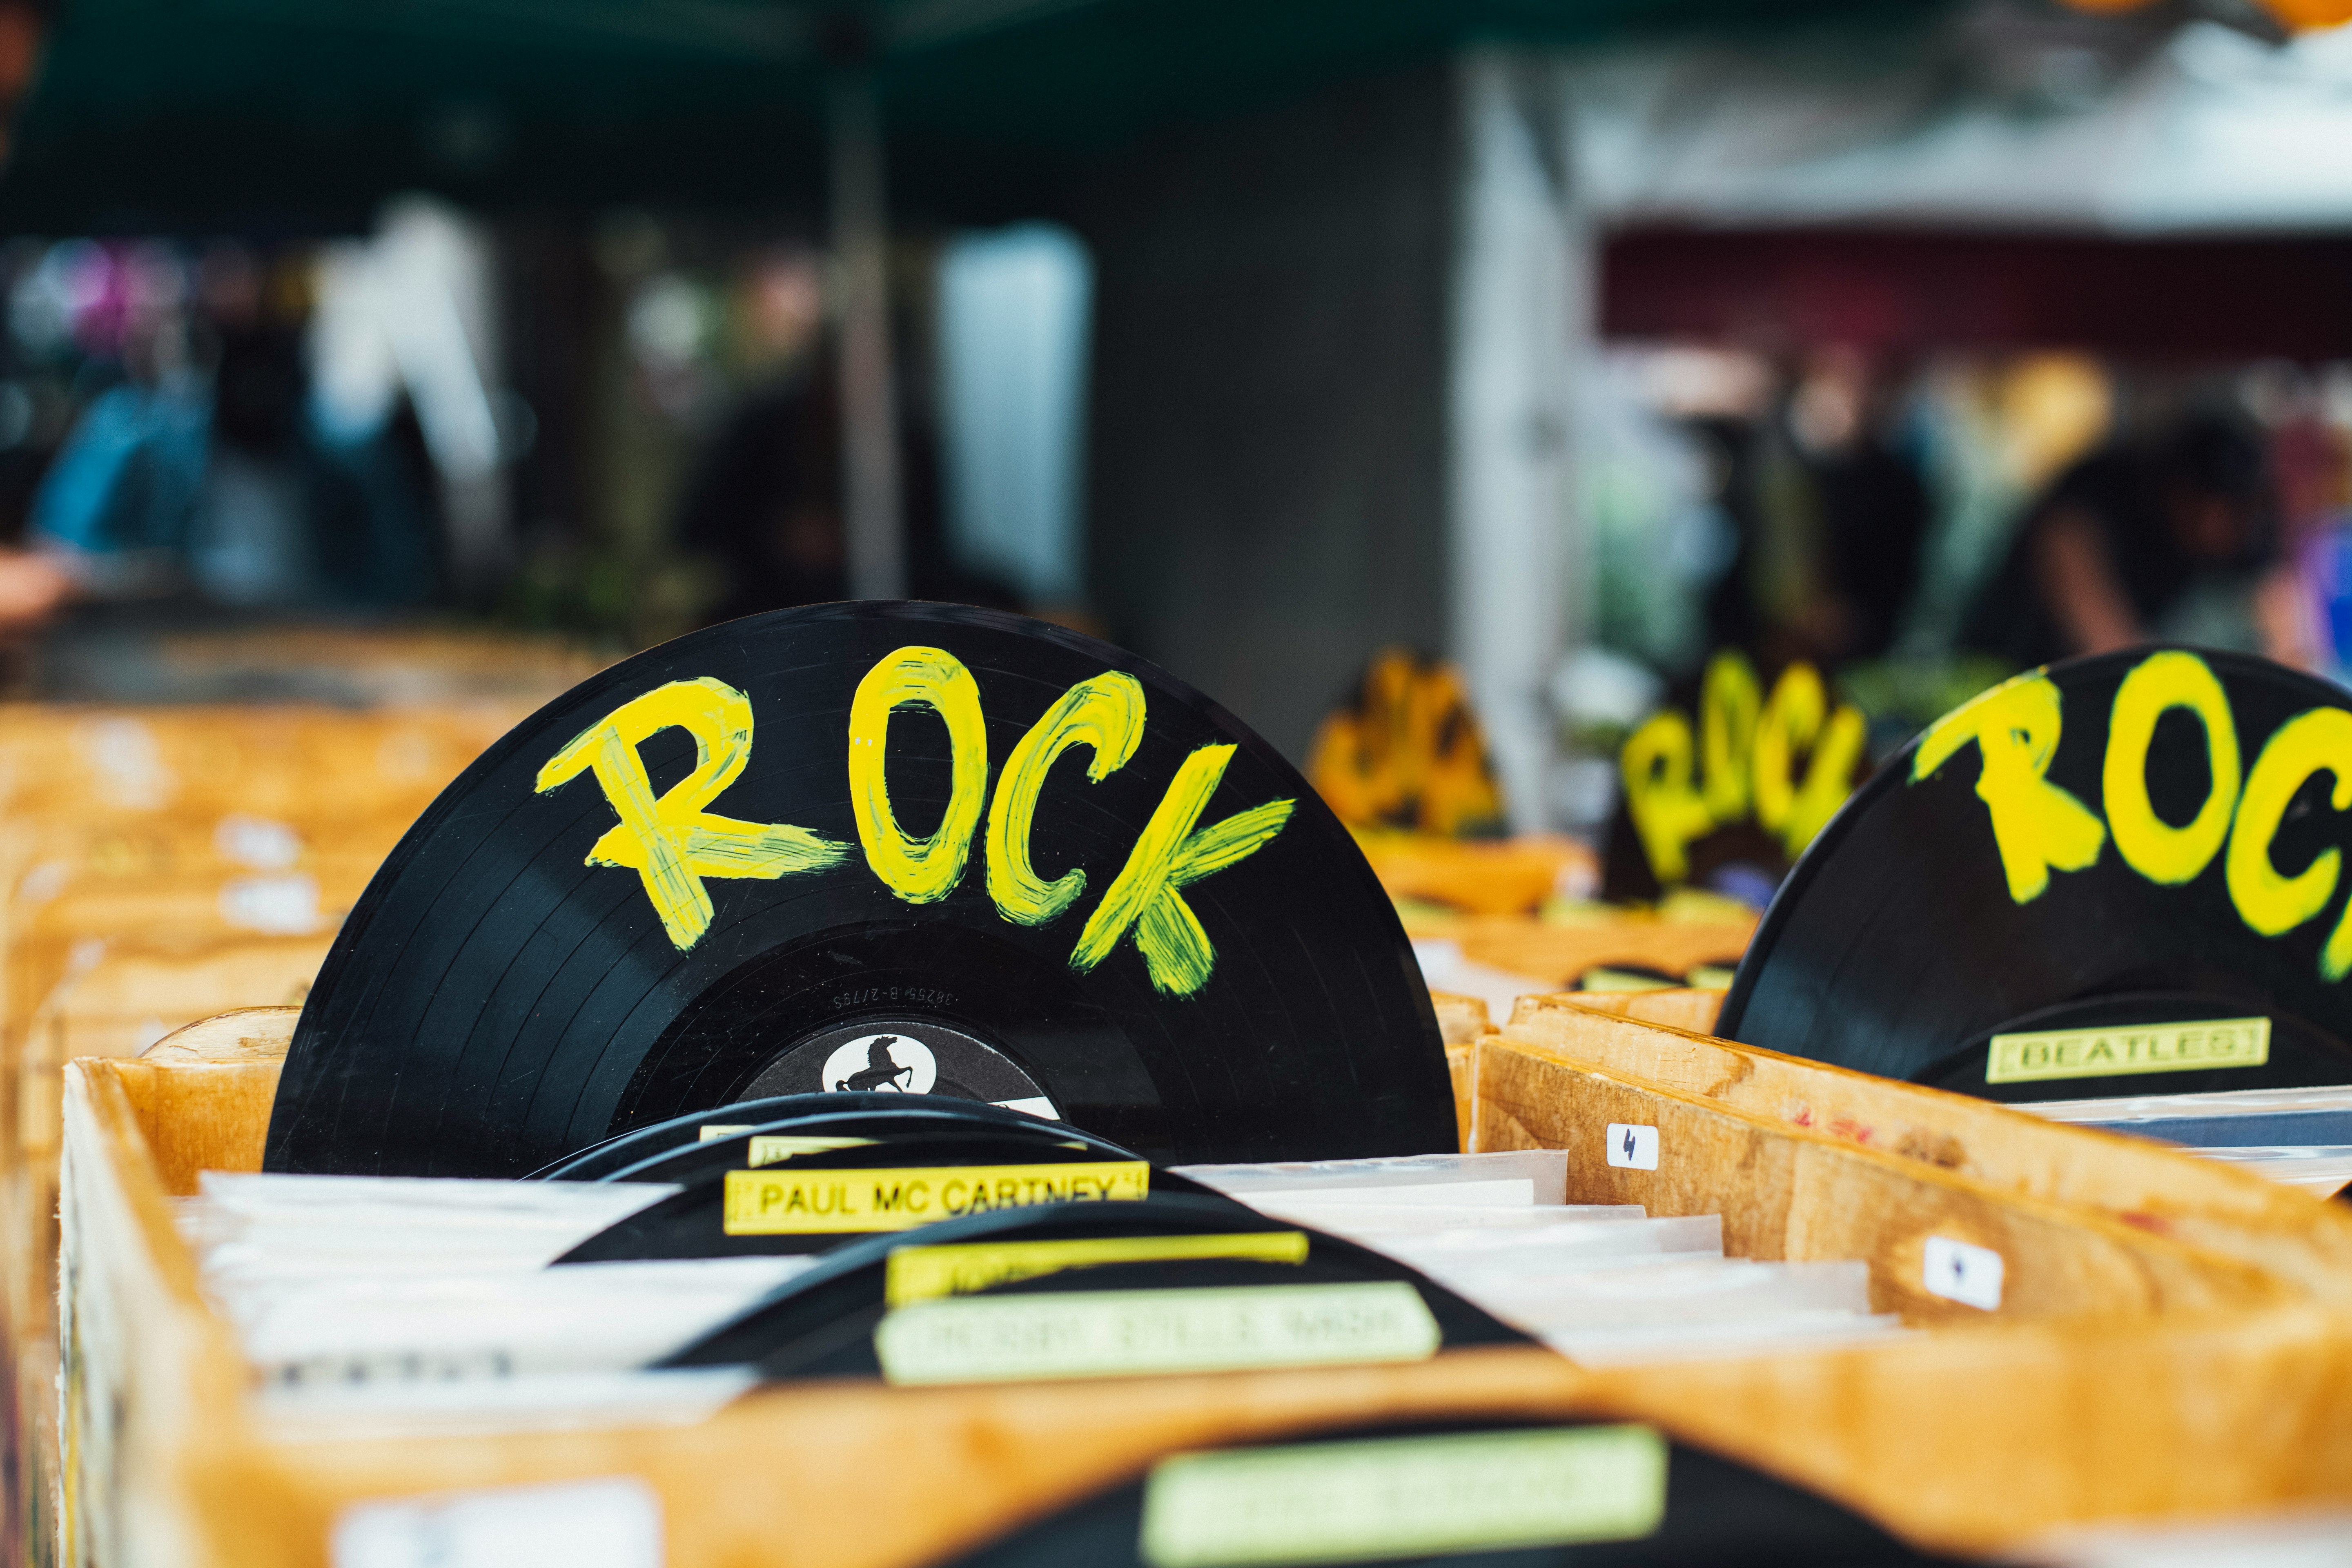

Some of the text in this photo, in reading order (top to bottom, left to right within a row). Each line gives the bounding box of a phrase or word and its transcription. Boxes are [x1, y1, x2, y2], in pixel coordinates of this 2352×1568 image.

[534, 645, 1296, 1000] ROCK
[1907, 649, 2352, 982] ROC
[2020, 1027, 2238, 1066] BEATLES
[760, 1174, 1117, 1216] PAUL MC CARTNEY
